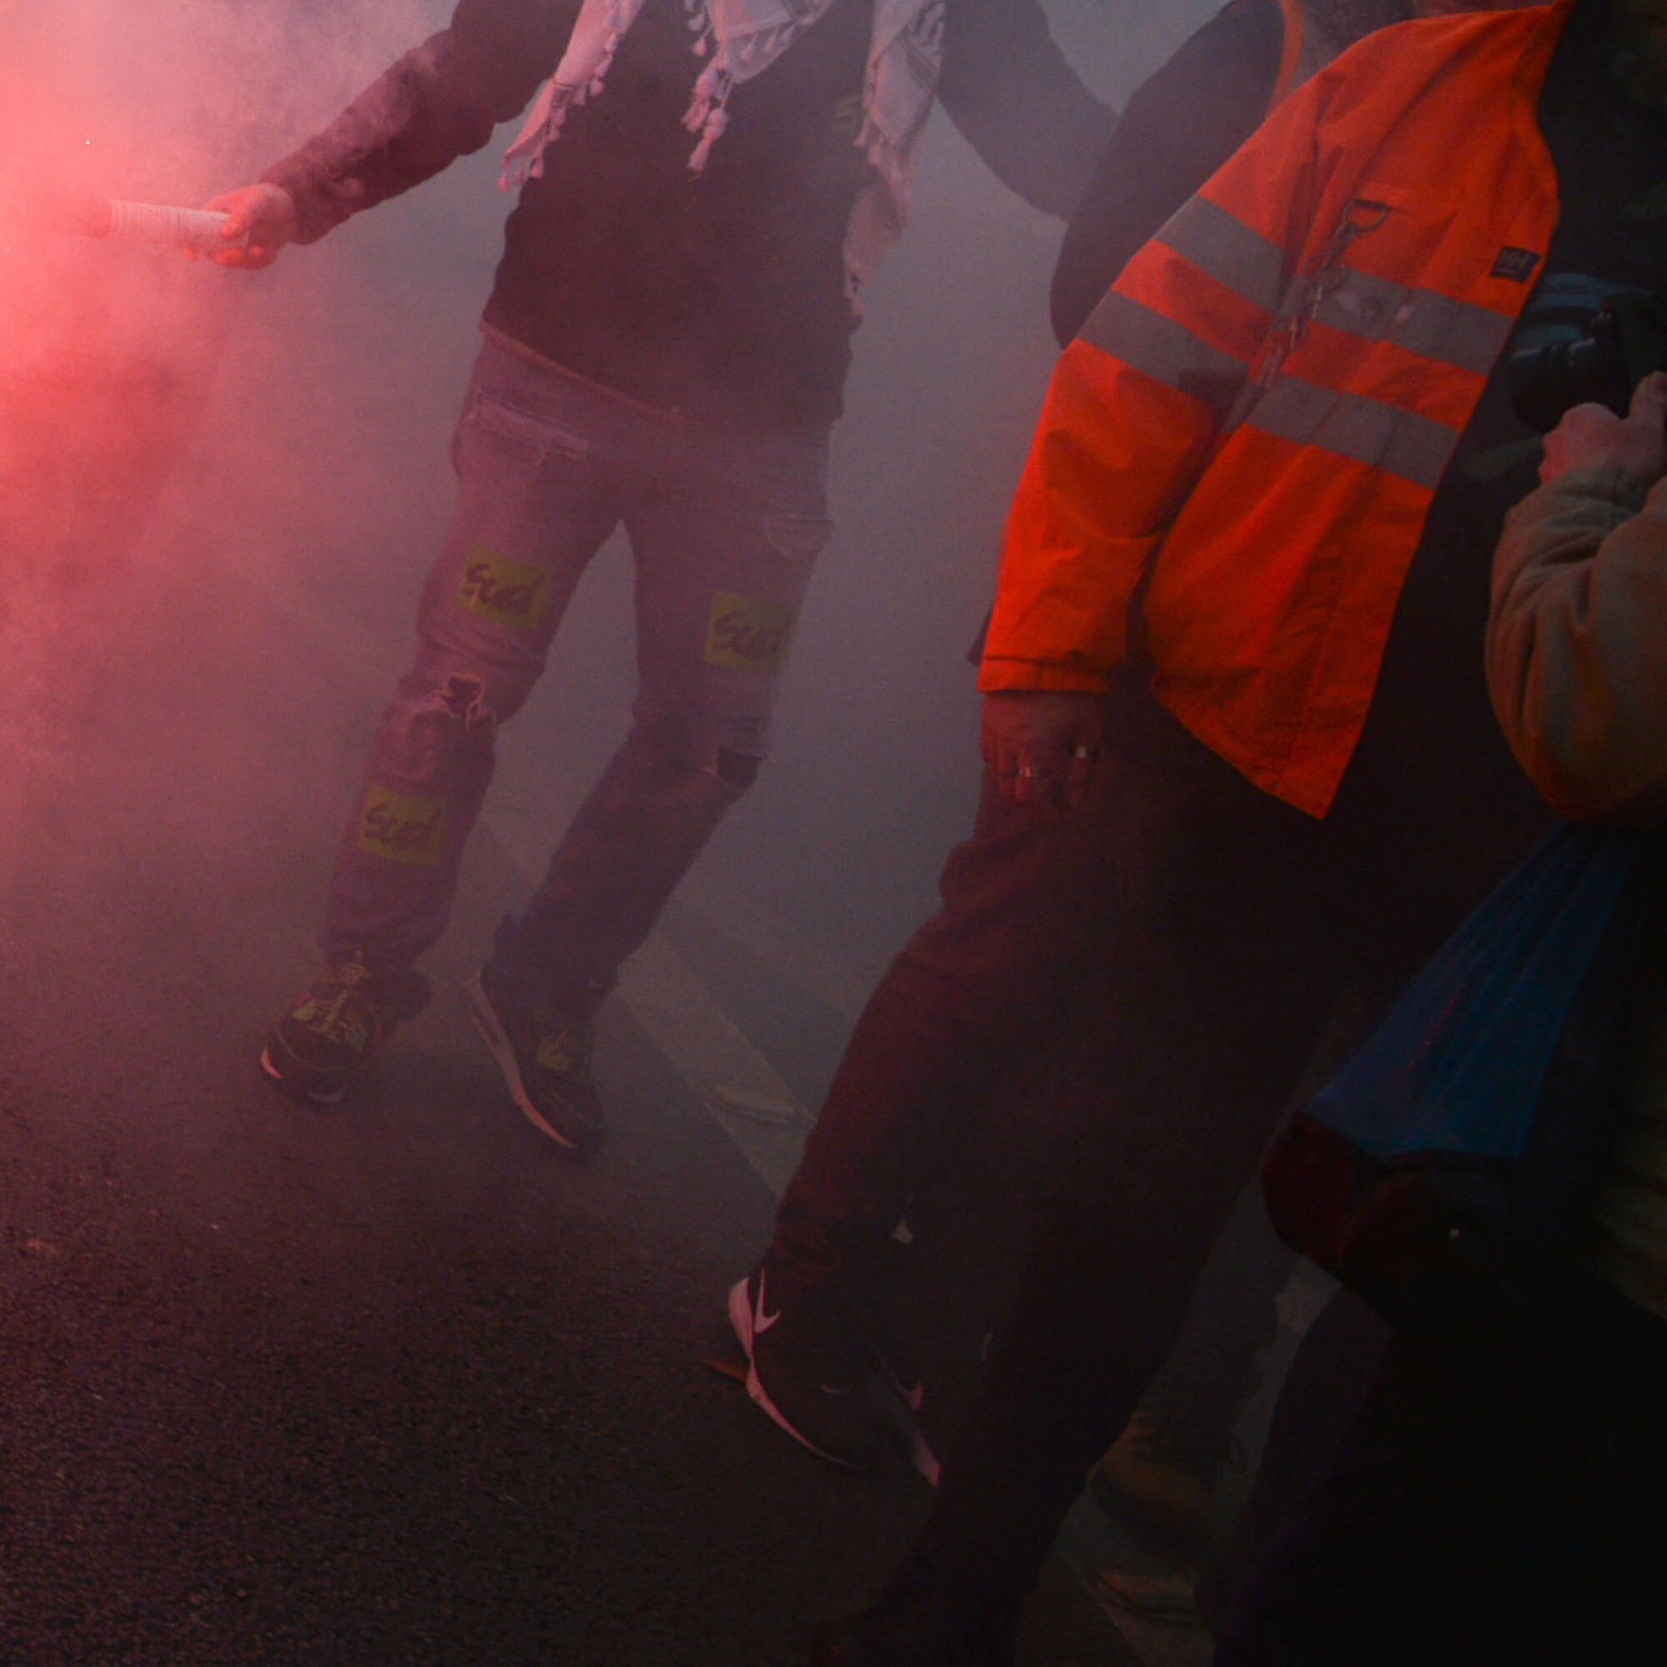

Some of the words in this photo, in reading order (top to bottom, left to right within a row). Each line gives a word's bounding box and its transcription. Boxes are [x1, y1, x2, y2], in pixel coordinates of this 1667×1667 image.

[466, 562, 548, 614] Sud
[712, 610, 793, 657] Sud
[365, 802, 444, 846] Sud
